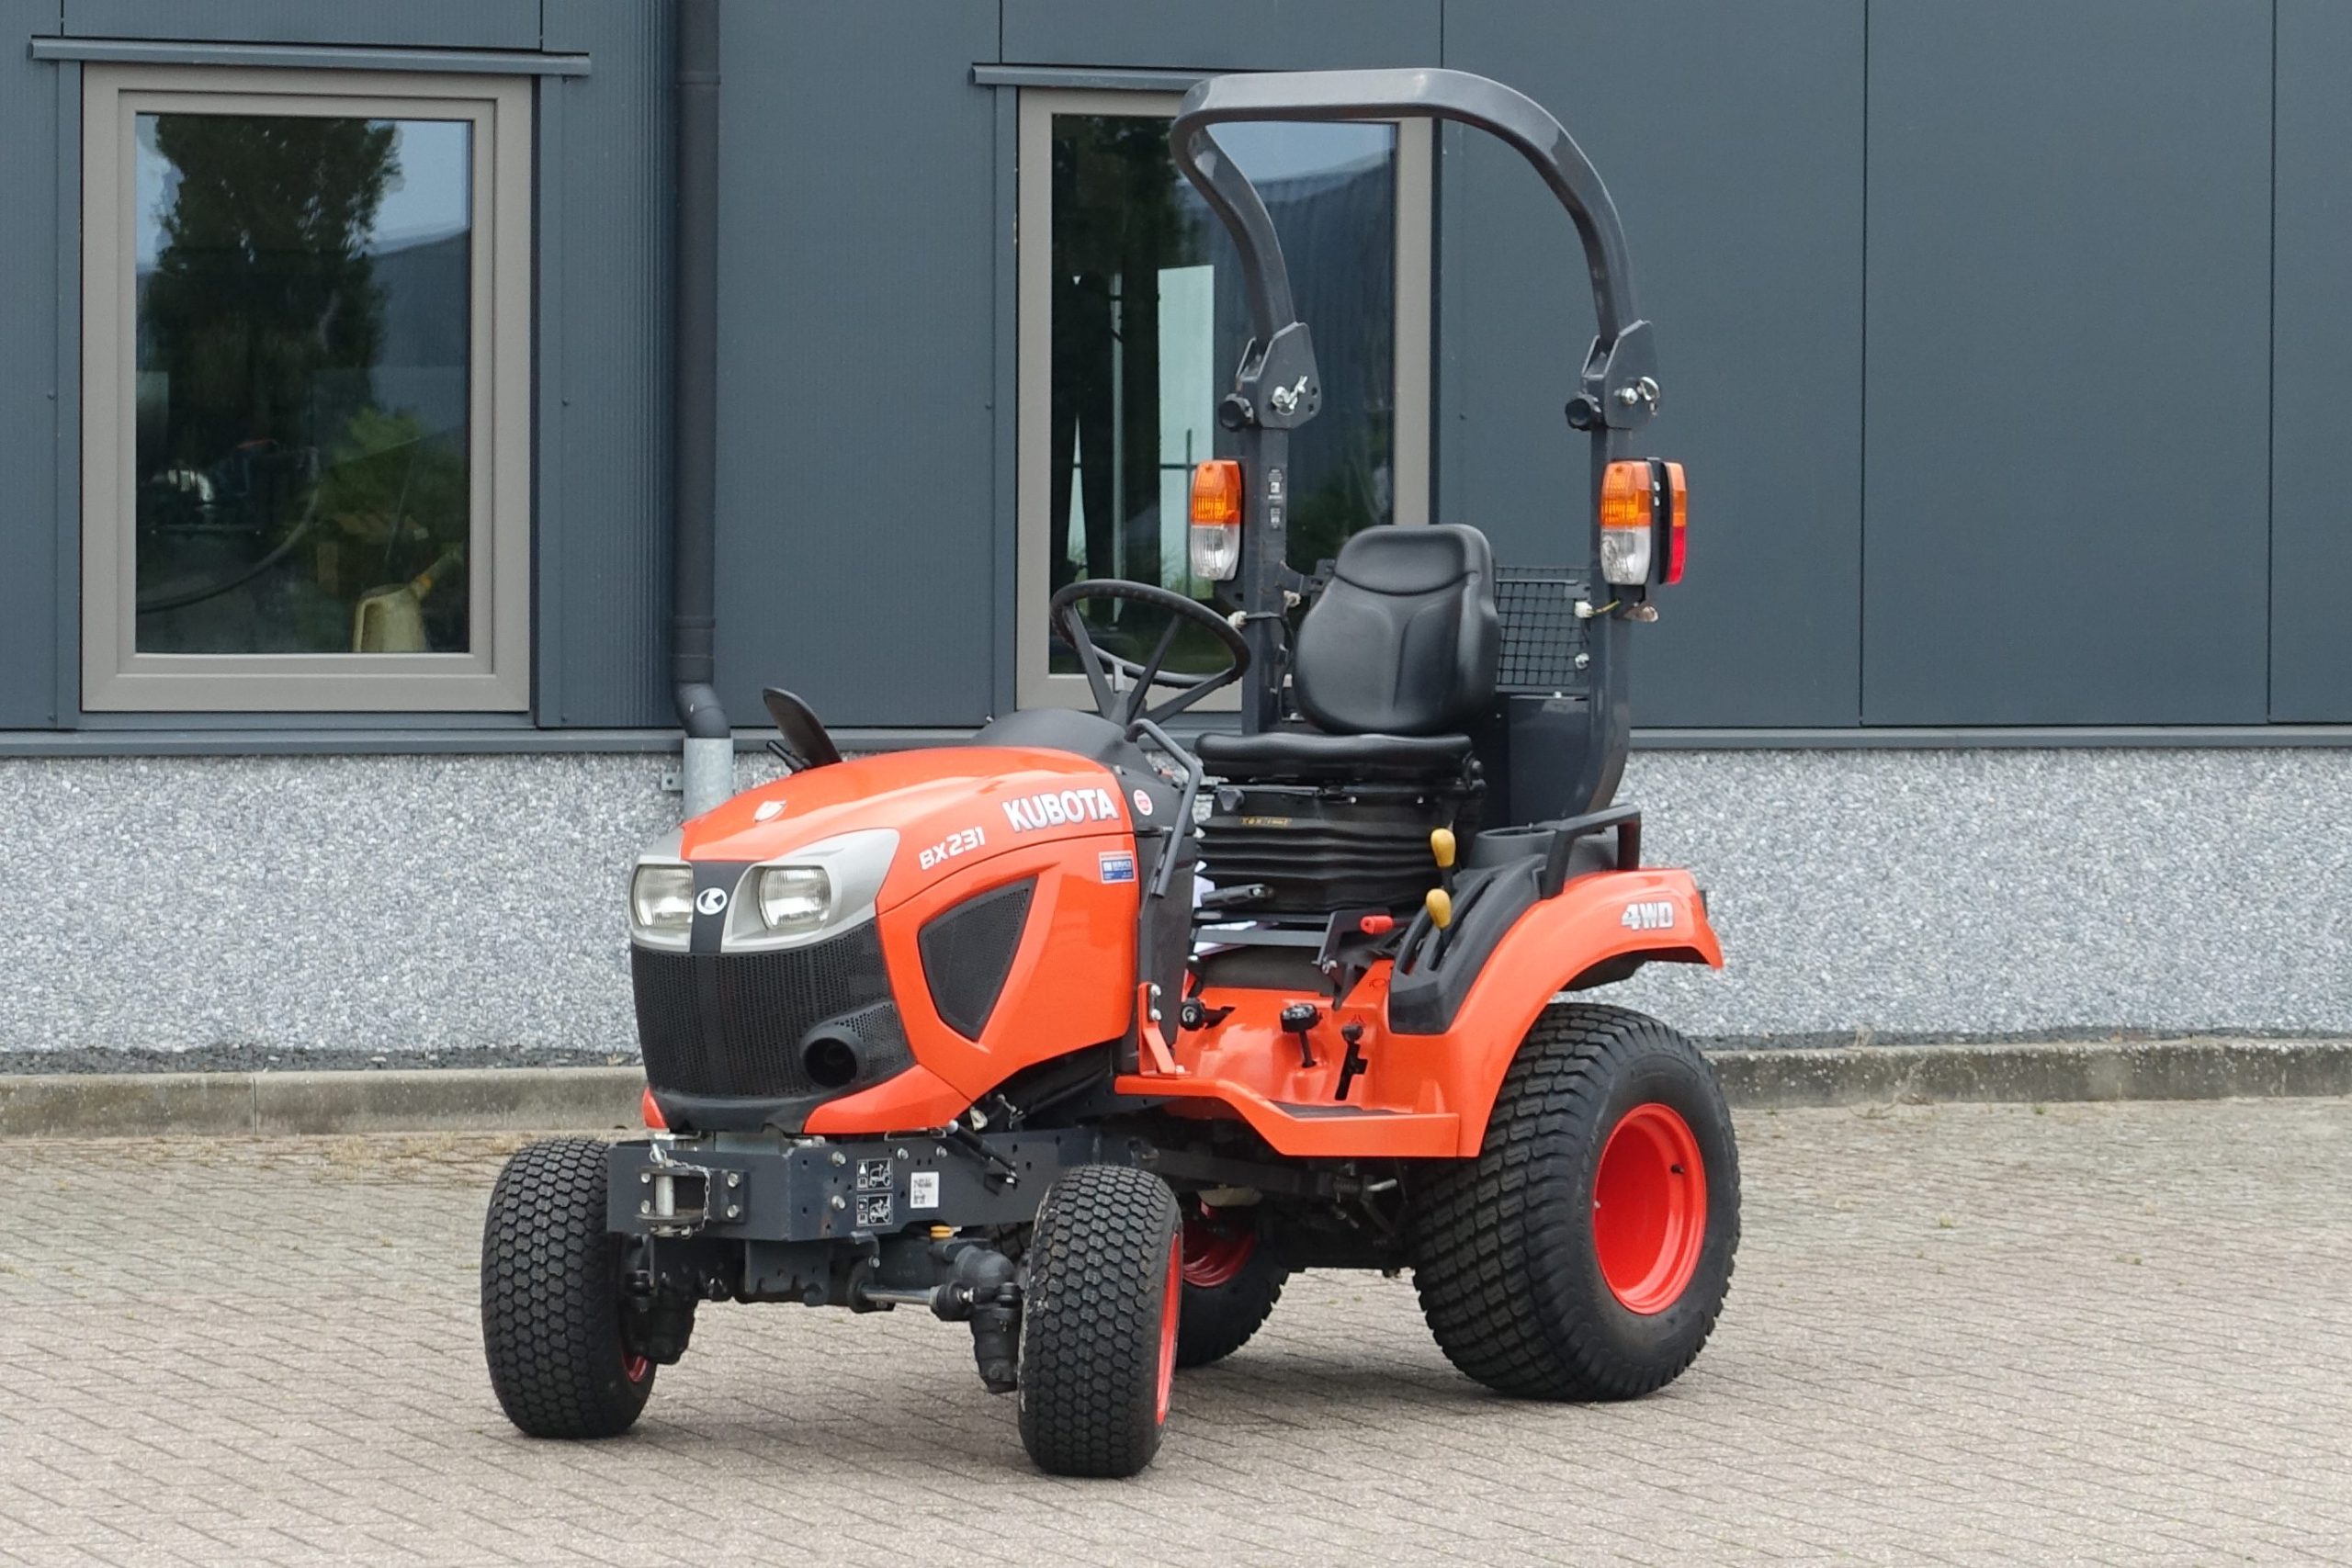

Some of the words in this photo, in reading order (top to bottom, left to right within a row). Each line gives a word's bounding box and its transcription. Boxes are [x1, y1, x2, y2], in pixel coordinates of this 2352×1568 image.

[1001, 788, 1119, 832] KUBOTA
[919, 826, 985, 870] BX231
[1621, 901, 1673, 930] 4WD
